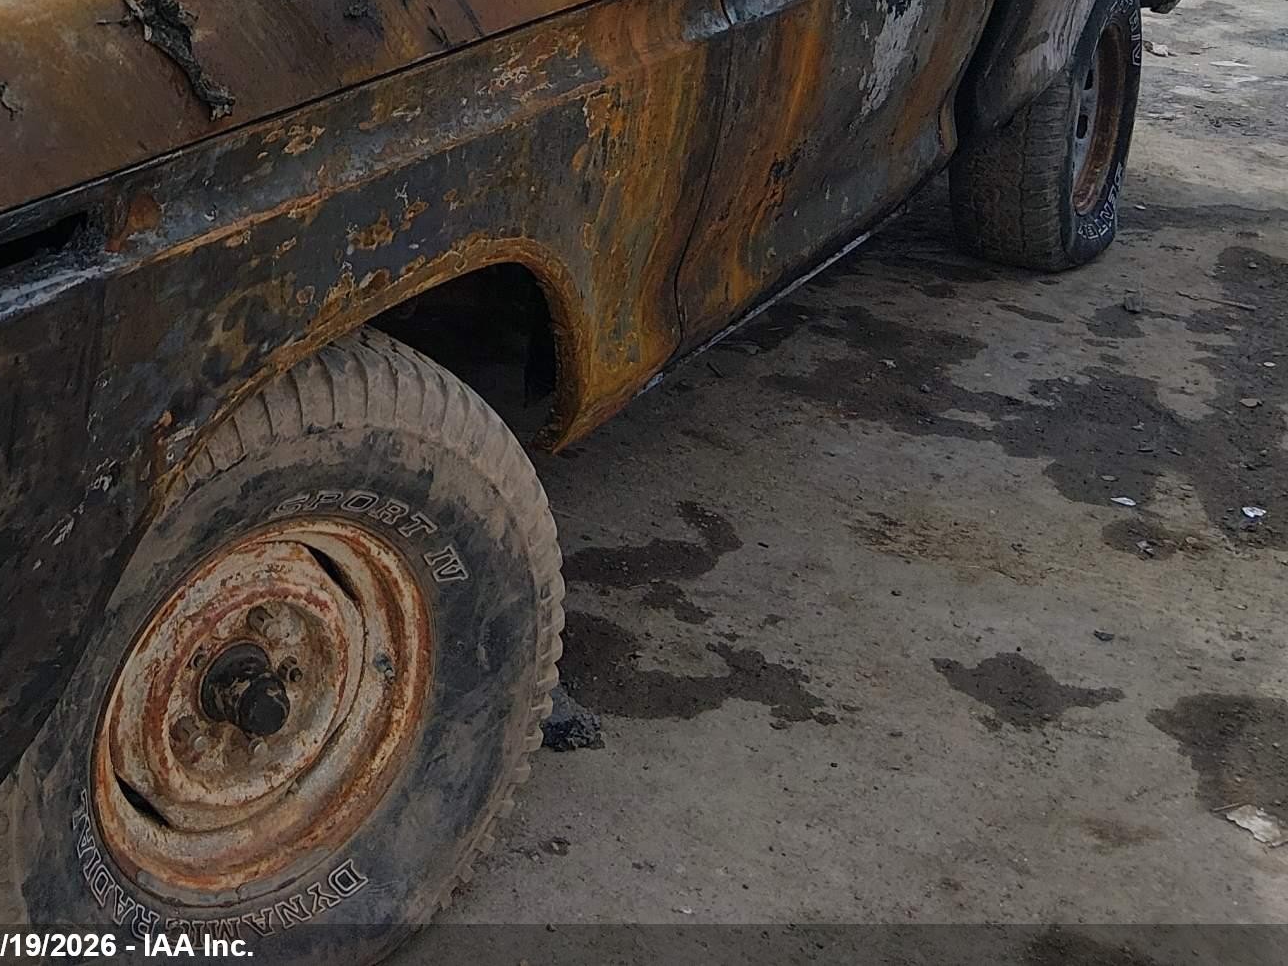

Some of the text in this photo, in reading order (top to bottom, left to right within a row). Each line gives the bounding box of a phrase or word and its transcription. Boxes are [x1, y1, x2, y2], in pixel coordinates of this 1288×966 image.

[268, 489, 469, 583] SPORT IV
[72, 787, 369, 950] DYNAMIC RADIAL
